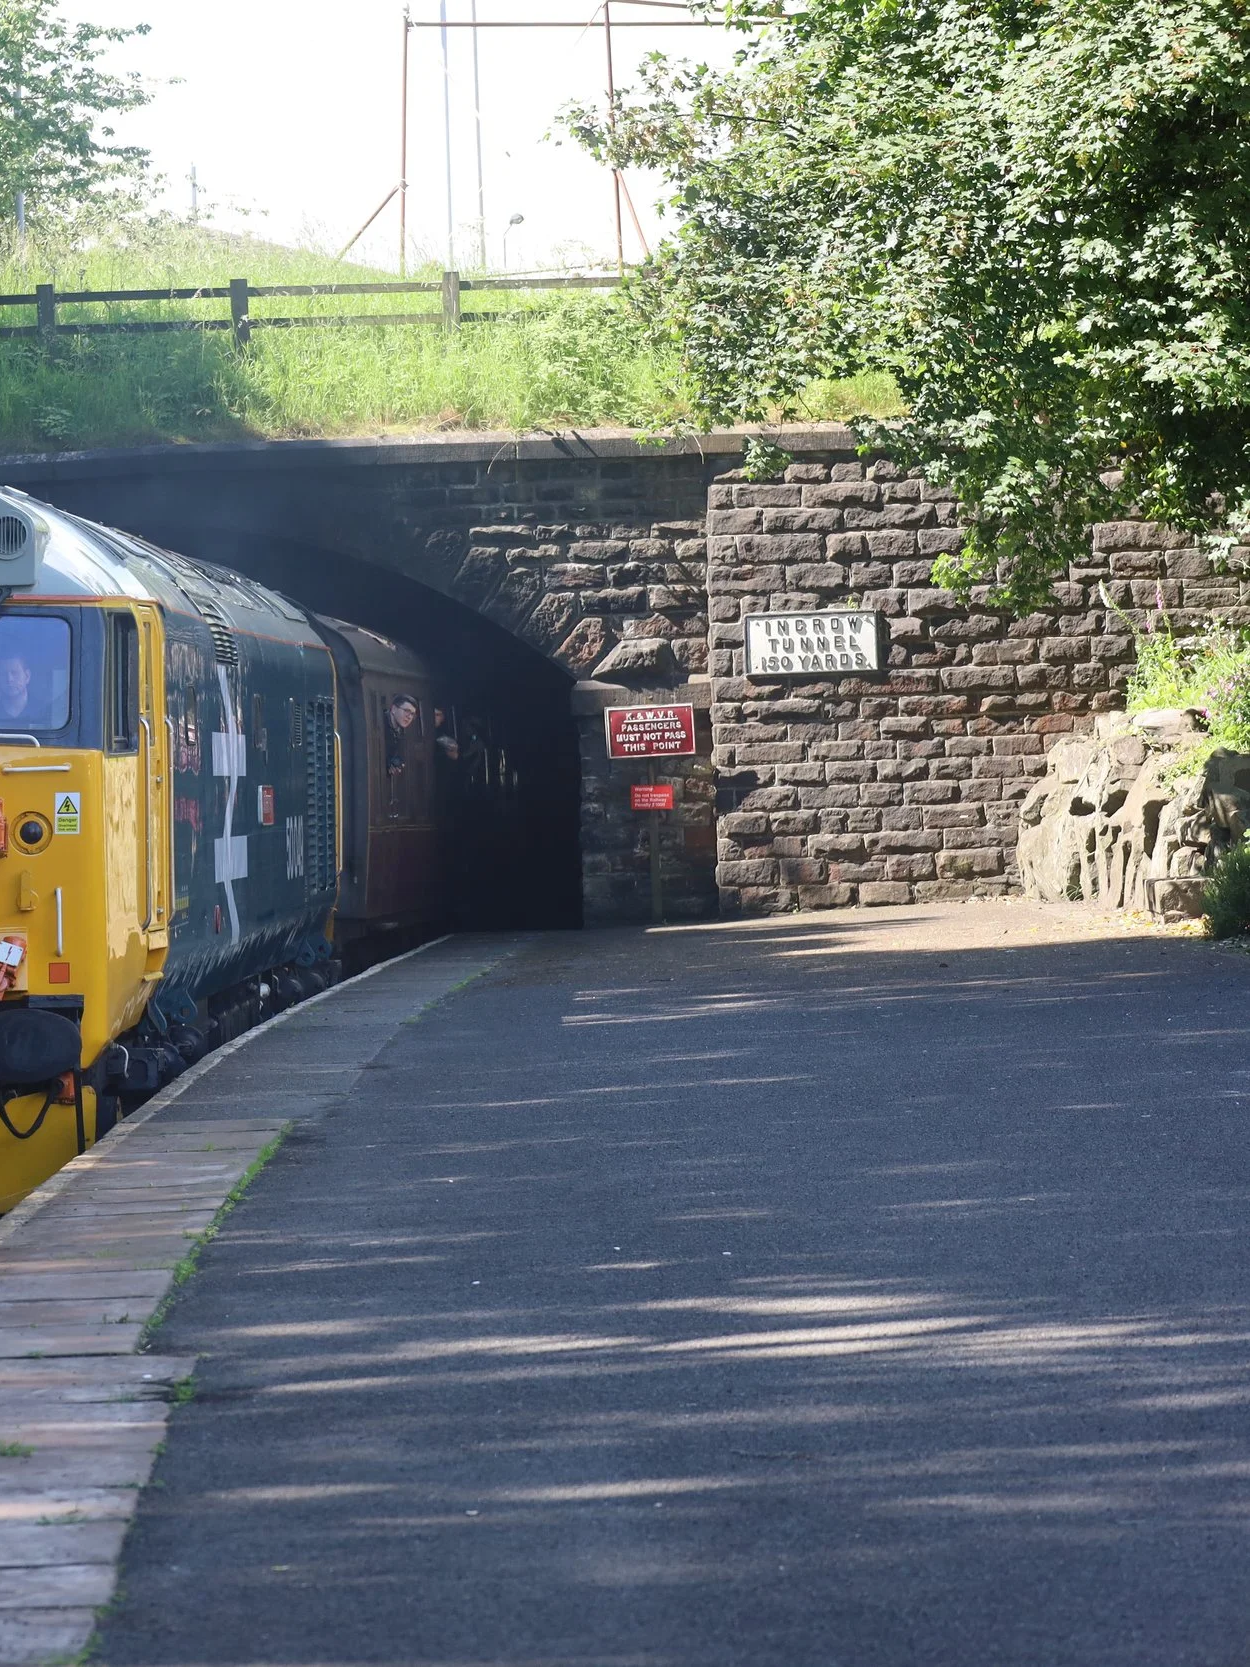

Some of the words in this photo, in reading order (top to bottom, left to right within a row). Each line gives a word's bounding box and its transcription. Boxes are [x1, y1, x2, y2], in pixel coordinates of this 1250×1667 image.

[765, 616, 863, 636] INGROW
[768, 635, 861, 654] TUNNEL
[761, 655, 794, 672] 150
[798, 652, 867, 671] YARDS
[616, 733, 641, 742] MUST
[643, 732, 662, 741] NOT
[664, 731, 687, 739] PASS
[623, 743, 646, 752] THIS
[652, 741, 681, 750] POINT
